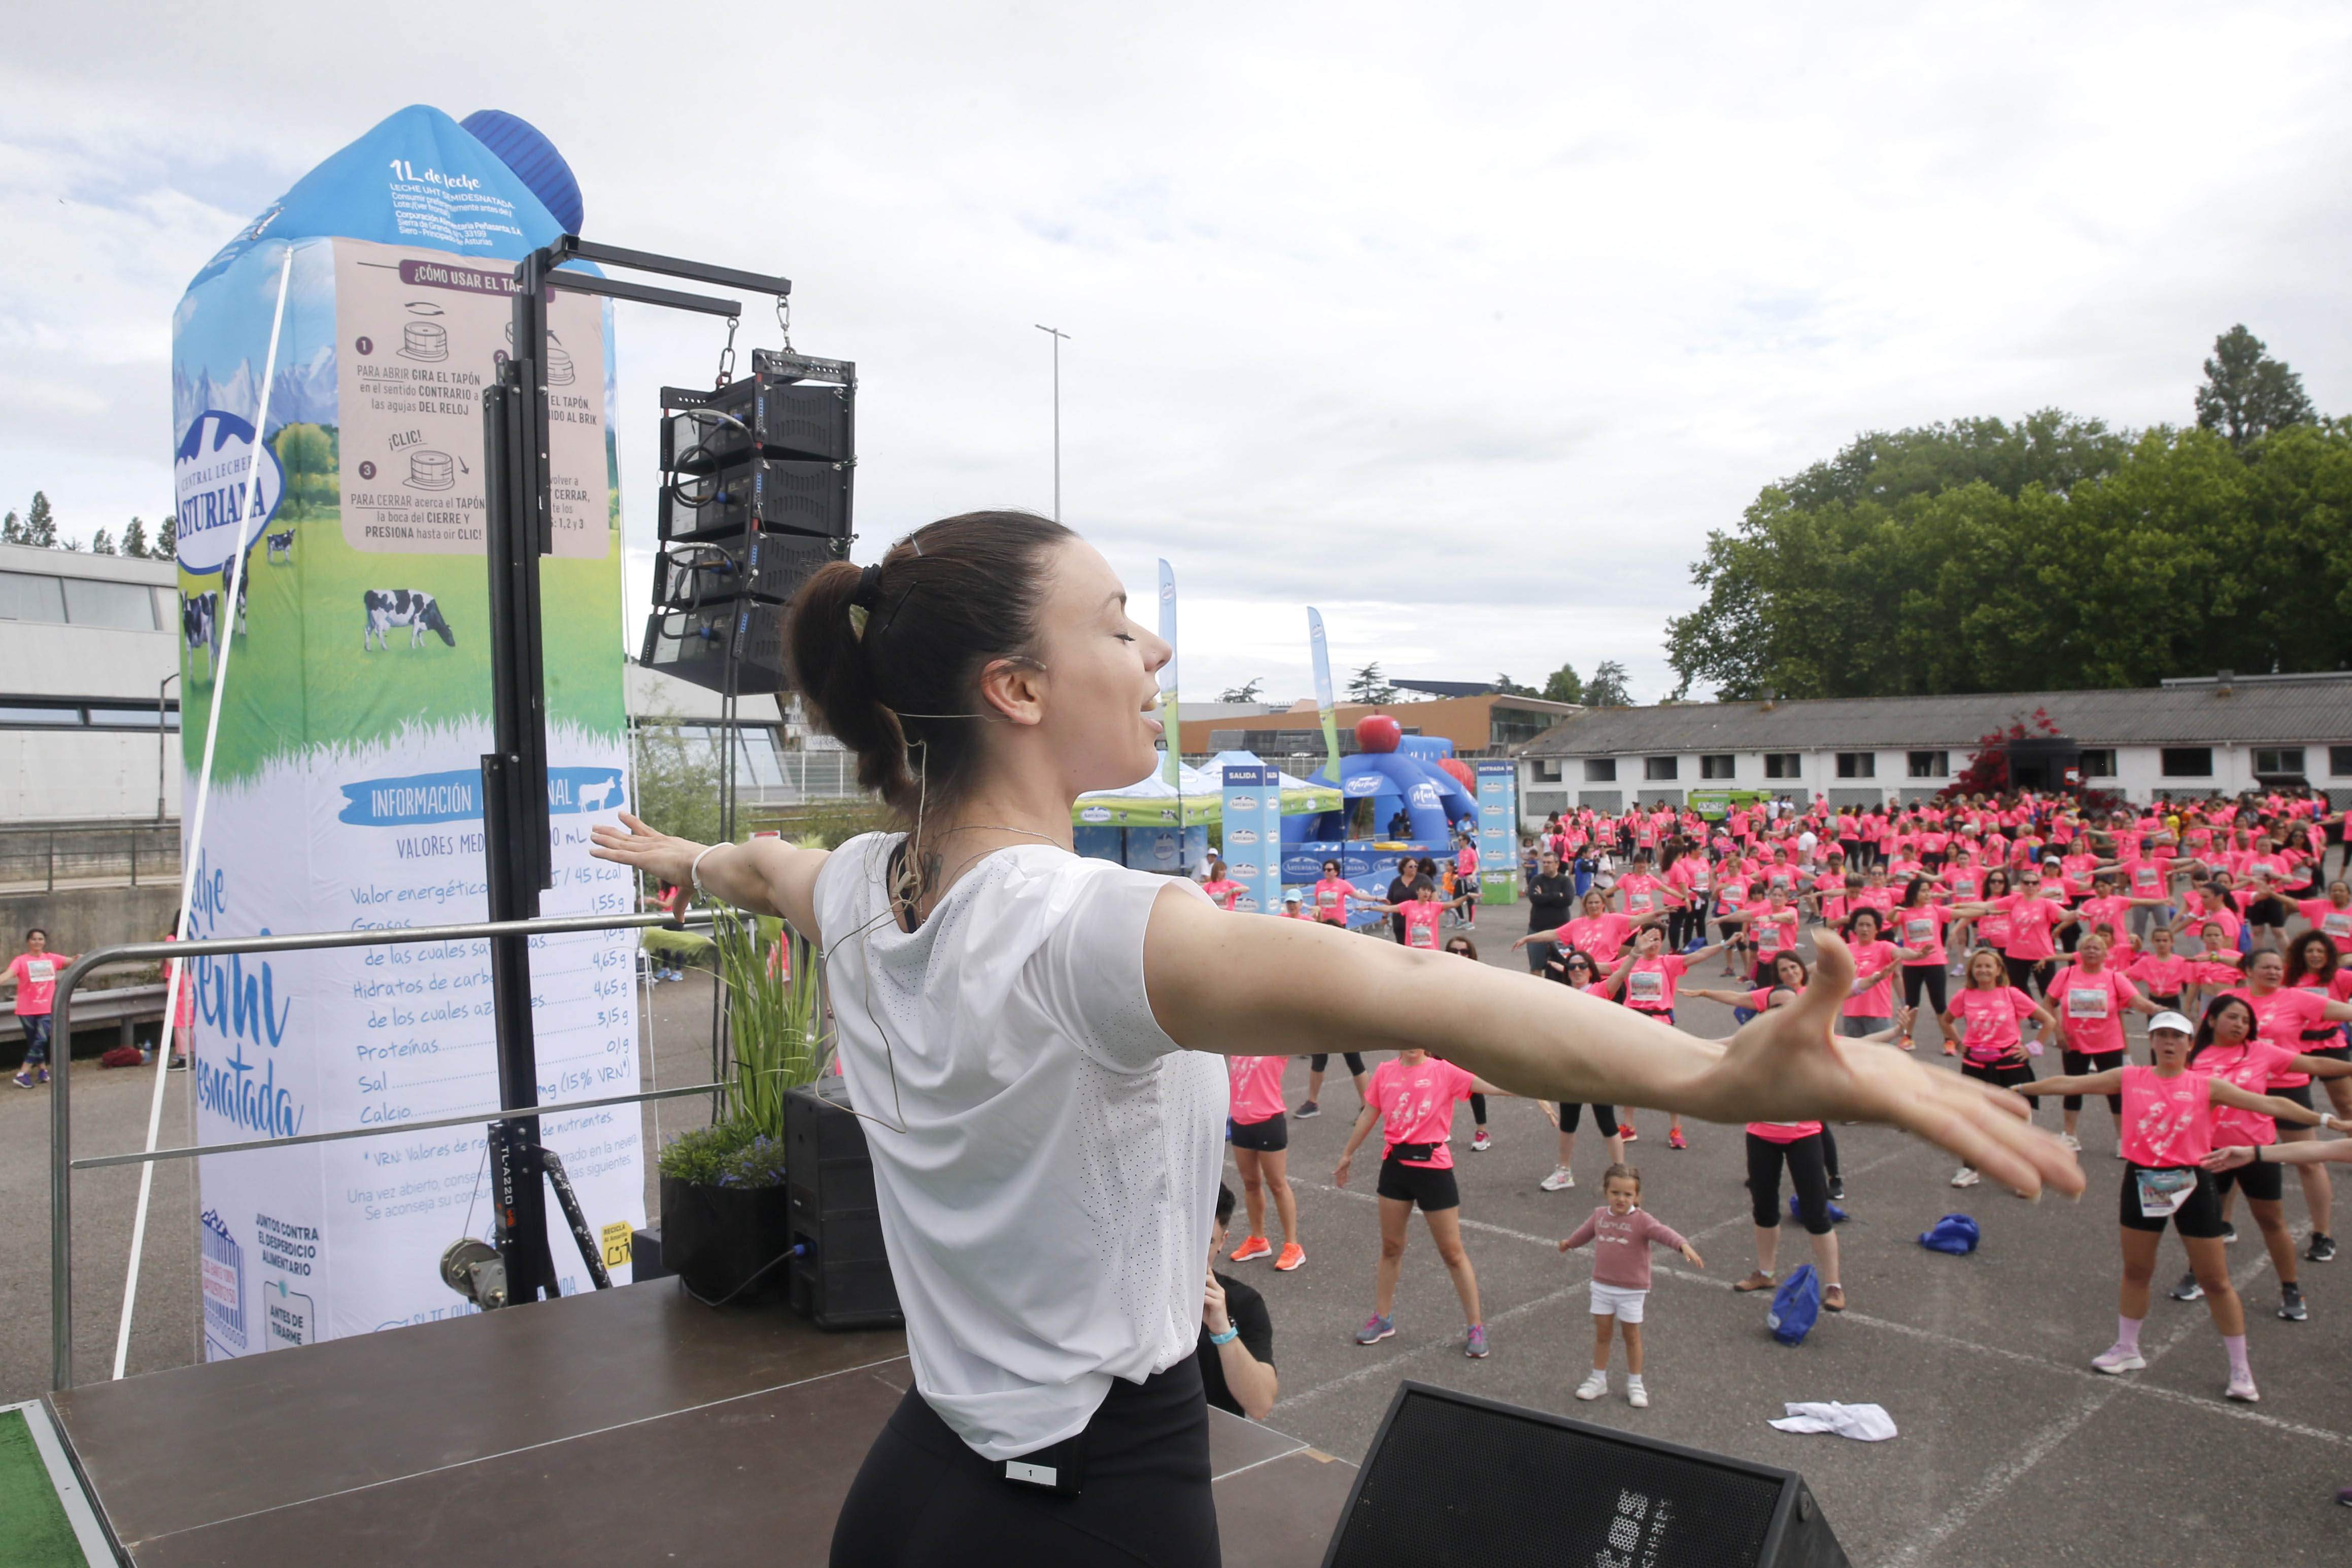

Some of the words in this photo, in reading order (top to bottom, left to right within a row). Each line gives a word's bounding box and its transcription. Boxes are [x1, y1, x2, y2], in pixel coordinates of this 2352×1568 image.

[390, 183, 422, 193] LECHE
[422, 186, 440, 196] UHT
[425, 168, 442, 184] de
[444, 174, 481, 191] leche
[414, 264, 448, 283] ¿CÓMO
[451, 270, 482, 288] USAR
[485, 276, 499, 290] EL
[357, 365, 380, 378] PARA
[383, 366, 409, 380] ABRIR
[412, 369, 434, 382] GIRA
[437, 371, 449, 383] EL
[451, 371, 481, 386] TAPÓN
[360, 384, 370, 393] en
[373, 383, 381, 394] el
[384, 384, 416, 396] sentido
[419, 385, 471, 400] CONTRARIO
[474, 392, 479, 401] a
[551, 395, 561, 406] EL
[371, 398, 385, 410] las
[387, 401, 417, 414] agujas
[419, 401, 437, 413] DEL
[439, 402, 469, 416] RELOJ
[567, 412, 577, 423] AL
[579, 413, 597, 426] BRIK
[388, 429, 423, 451] ¡CLIC!
[363, 465, 371, 476] 3
[574, 478, 578, 486] a
[351, 493, 374, 506] PARA
[377, 494, 412, 507] CERRAR
[415, 497, 444, 508] acerca
[446, 497, 454, 508] el
[456, 495, 485, 510] TAPÓN
[554, 489, 590, 503] CERRAR,
[377, 510, 385, 522] la
[388, 511, 408, 523] boca
[411, 511, 424, 523] del
[427, 512, 461, 524] CIERRE
[463, 514, 470, 524] Y
[562, 503, 573, 514] los
[365, 526, 414, 538] PRESIONA
[417, 528, 441, 539] hasta
[458, 529, 482, 540] CLIC!
[572, 520, 577, 531] y
[579, 519, 584, 529] 3
[371, 782, 472, 818] INFORMACIÓN
[396, 835, 454, 860] VALORES
[565, 827, 587, 845] mL
[350, 887, 393, 906] Valor
[397, 879, 488, 904] energético
[575, 867, 592, 883] 45
[591, 893, 617, 914] 1,55
[618, 897, 625, 913] g
[365, 948, 385, 966] de
[390, 944, 412, 965] las
[417, 940, 466, 962] cuales
[354, 978, 424, 1000] Hidratos
[429, 973, 448, 991] de
[592, 950, 618, 972] 4,65
[620, 953, 626, 969] g
[367, 1010, 387, 1029] de
[393, 1005, 415, 1026] los
[420, 1000, 469, 1023] cuales
[594, 978, 619, 1001] 4,65
[621, 981, 627, 998] g
[356, 1038, 438, 1062] Proteínas
[597, 1006, 620, 1029] 3,15
[622, 1009, 629, 1026] g
[358, 1070, 387, 1095] Sal
[606, 1036, 621, 1055] 0,1
[623, 1038, 629, 1054] g
[360, 1098, 411, 1124] Calcio
[560, 1068, 593, 1093] (15%
[405, 1143, 450, 1162] Valores
[454, 1139, 468, 1153] de
[541, 1121, 554, 1136] de
[347, 1188, 373, 1204] Una
[377, 1187, 395, 1200] vez
[590, 1145, 601, 1157] en
[604, 1141, 612, 1154] la
[501, 1145, 513, 1205] TL-A220
[365, 1205, 381, 1220] Se
[385, 1198, 435, 1218] aconseja
[438, 1196, 451, 1208] su
[282, 1222, 319, 1241] CONTRA
[259, 1230, 265, 1244] EL
[266, 1234, 316, 1258] DESPERDICIO
[262, 1249, 311, 1276] ALIMENTARIO
[270, 1304, 291, 1324] ANTES
[292, 1314, 303, 1328] DE
[272, 1321, 302, 1346] TIRARME
